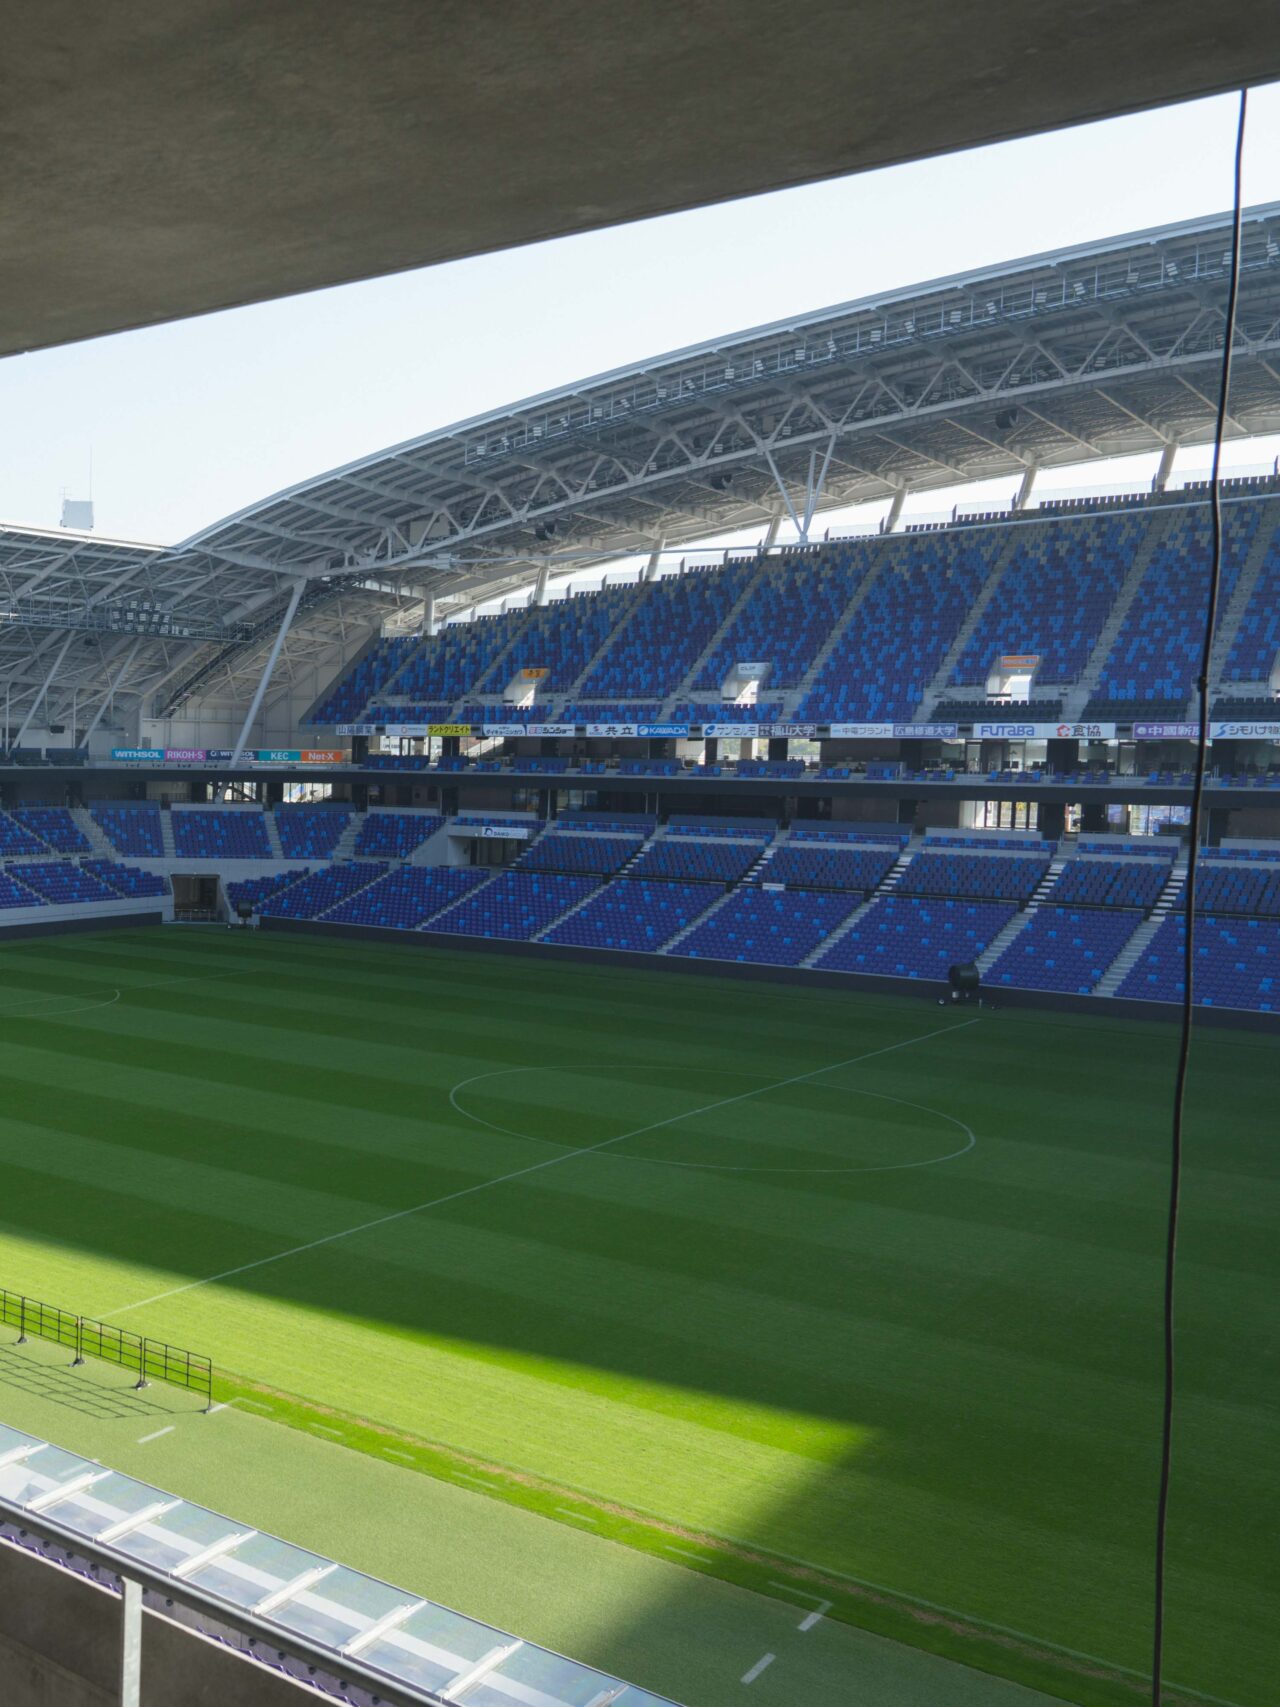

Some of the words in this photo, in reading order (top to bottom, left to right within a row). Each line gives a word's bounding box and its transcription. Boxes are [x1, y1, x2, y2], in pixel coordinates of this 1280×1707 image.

[771, 725, 815, 736] 福山大学
[115, 750, 160, 758] WITHSOL
[270, 752, 289, 760] KEC
[308, 752, 334, 760] Net-X
